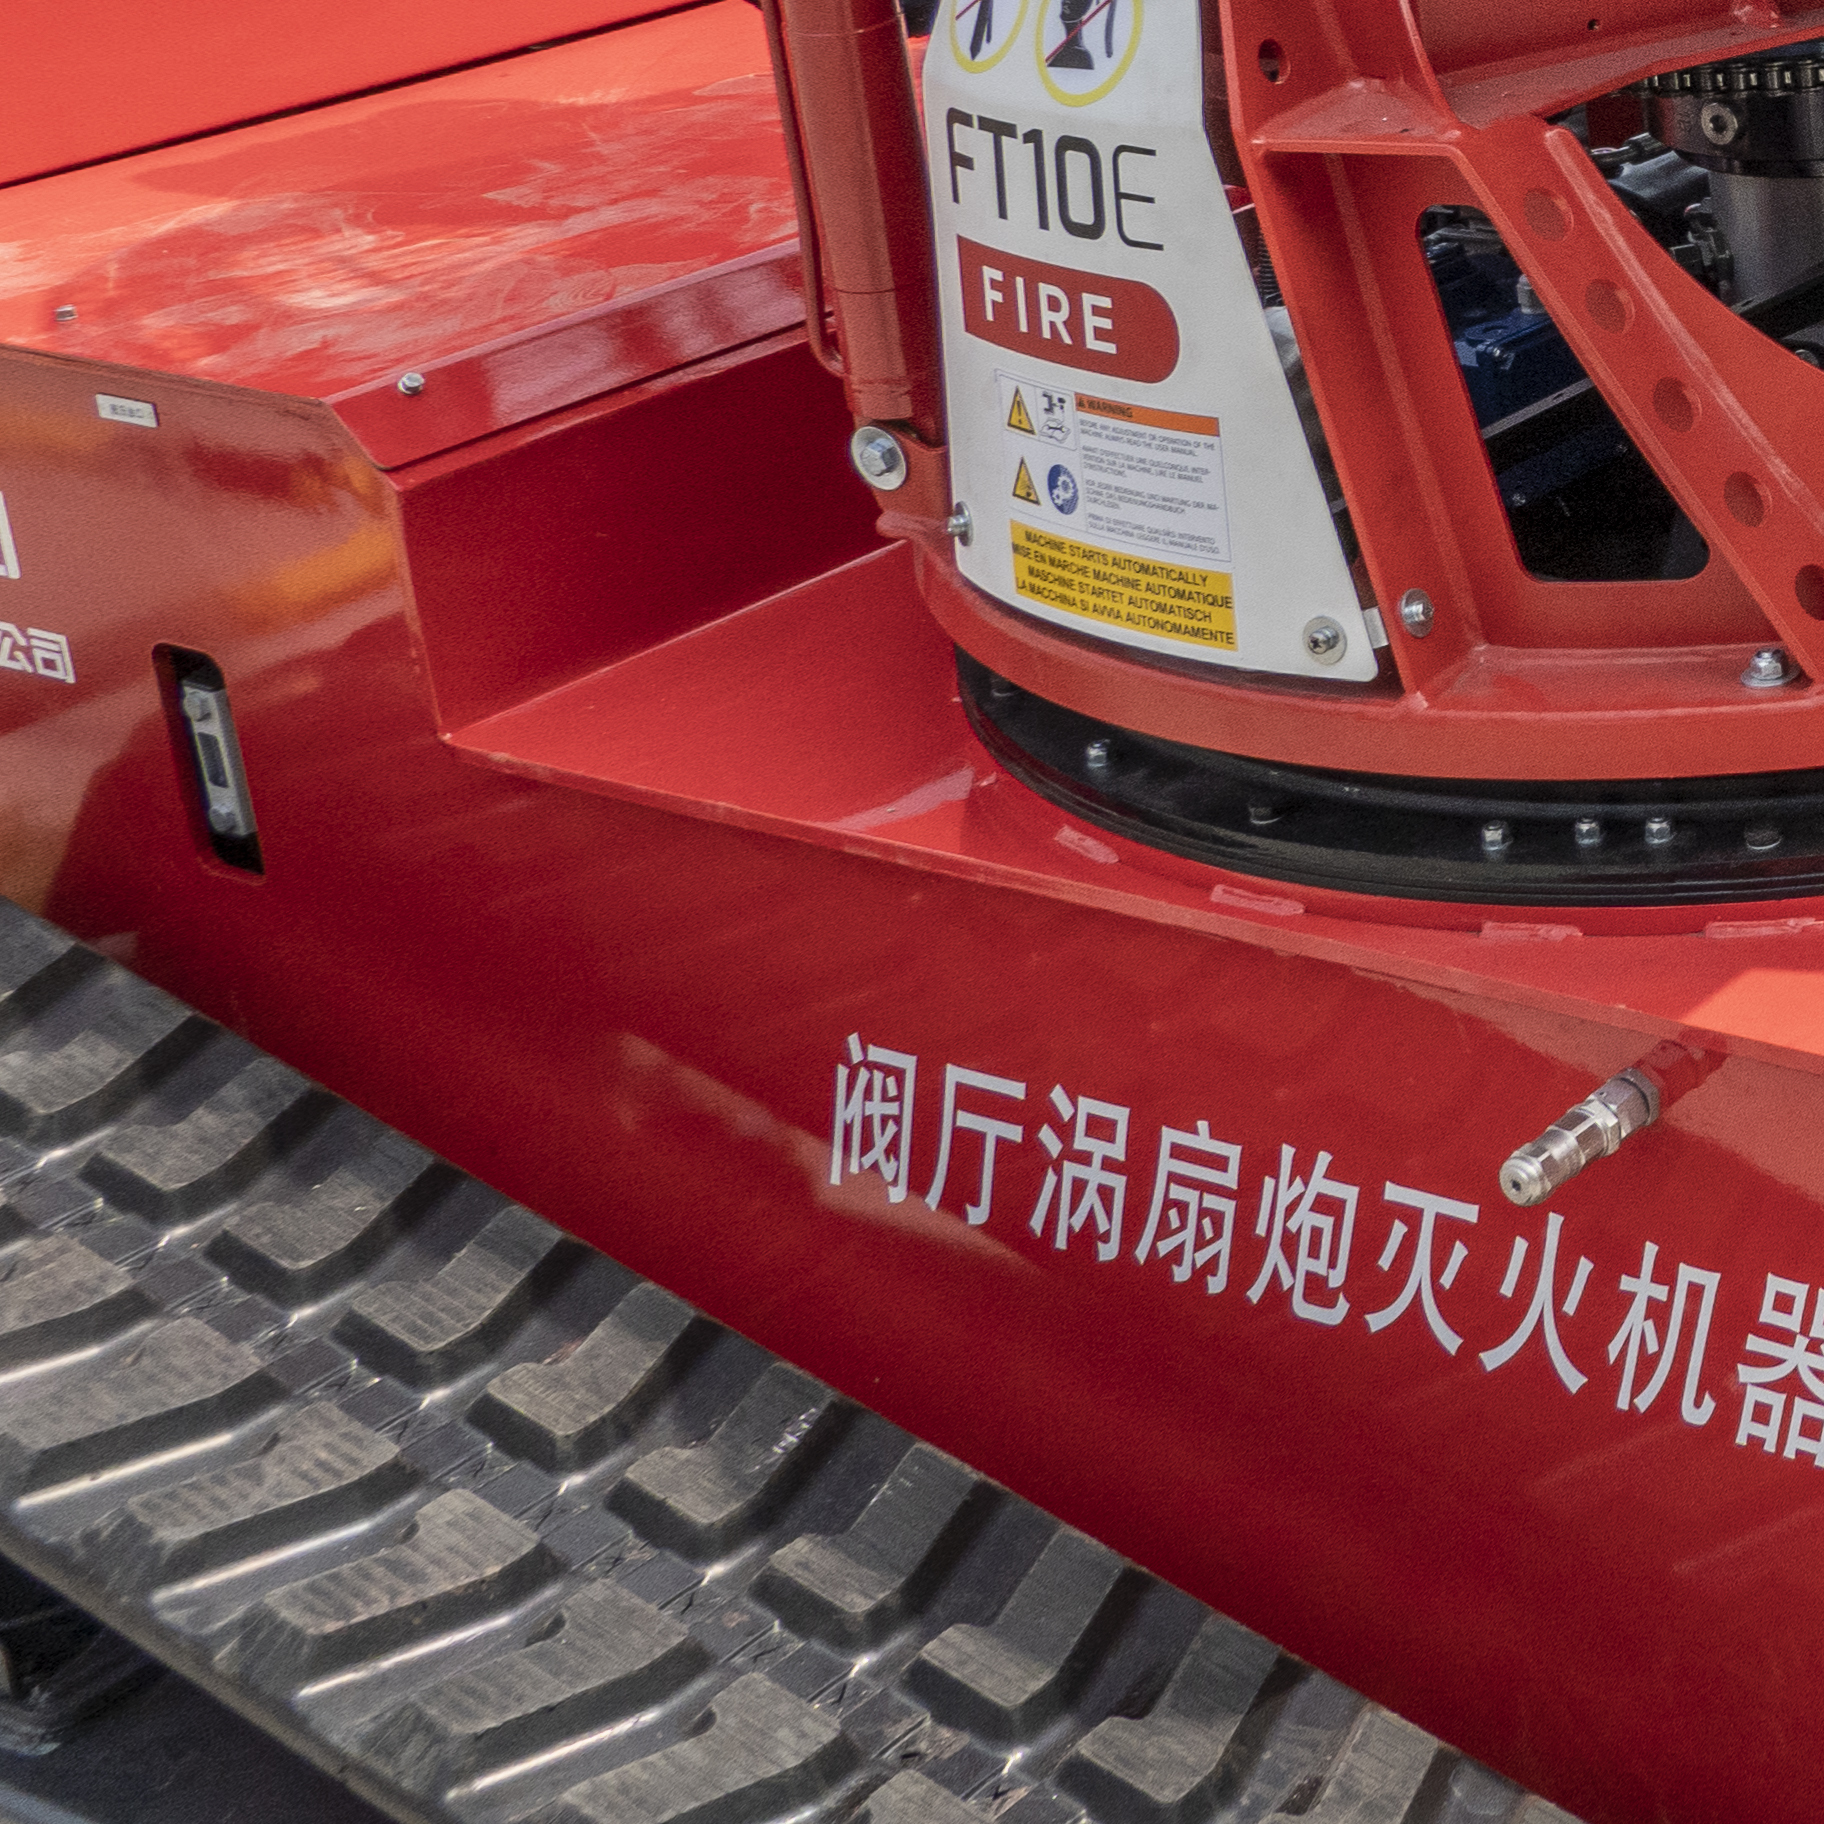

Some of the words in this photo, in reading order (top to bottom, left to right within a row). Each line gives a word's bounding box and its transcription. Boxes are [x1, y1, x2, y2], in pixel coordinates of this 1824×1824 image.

[946, 107, 1164, 251] FT10E
[981, 264, 1118, 356] FIRE
[1025, 531, 1067, 554] MACHINE
[1070, 545, 1109, 566] STARTS
[1111, 556, 1208, 588] AUTOMATICALLY
[1034, 550, 1046, 563] EN
[1048, 555, 1090, 577] MARCHE
[1092, 569, 1142, 591] MACHINE
[1145, 581, 1233, 610] AUTOMATIQUE
[1028, 565, 1076, 590] MASCHINE
[1078, 581, 1124, 604] STARTET
[1127, 595, 1213, 624] AUTOMATISCH
[1029, 581, 1076, 607] MACCHINA
[1080, 598, 1090, 612] SI
[1092, 601, 1122, 621] AVVIA
[1125, 610, 1234, 646] AUTONOMAMENTE
